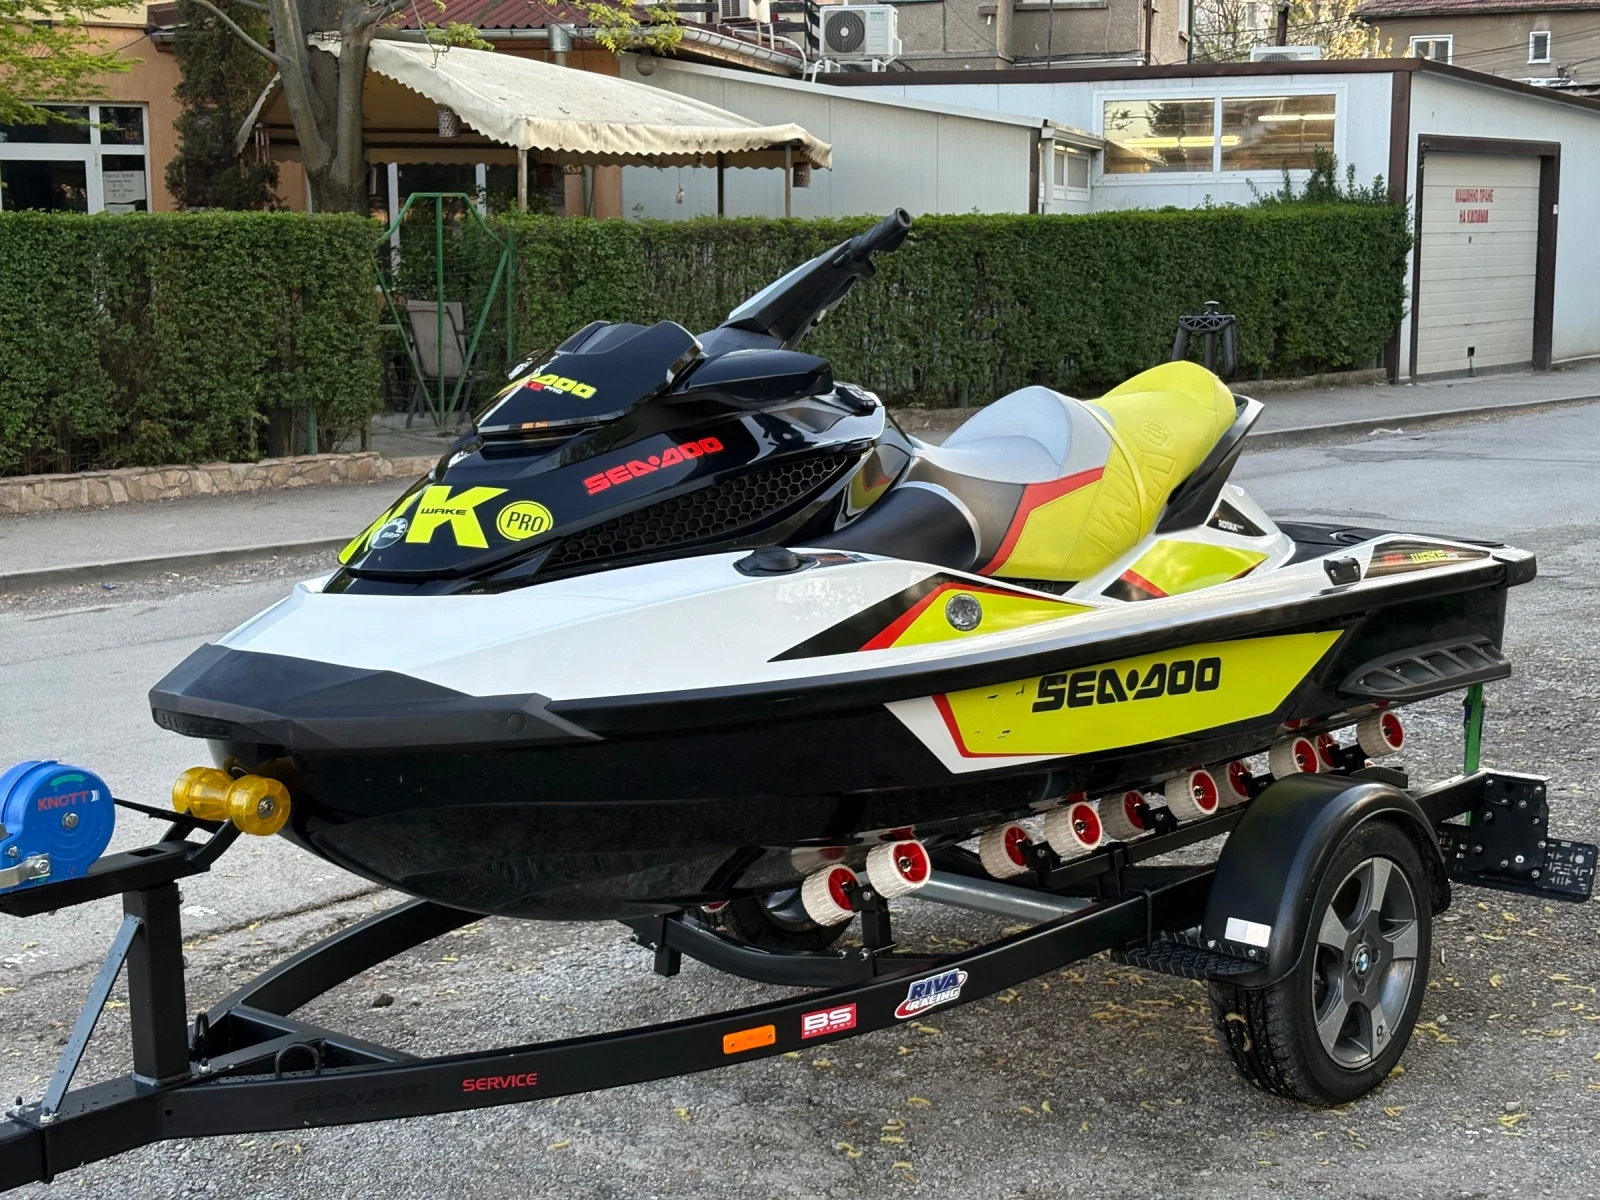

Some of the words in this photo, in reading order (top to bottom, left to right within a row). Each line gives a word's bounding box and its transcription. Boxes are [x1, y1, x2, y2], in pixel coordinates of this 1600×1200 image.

[1459, 209, 1466, 223] НА
[420, 507, 468, 516] WAKE
[506, 511, 545, 533] PRO
[37, 790, 90, 811] KNOTT
[910, 970, 960, 1000] RIVA
[906, 988, 961, 1011] RACING
[804, 1007, 853, 1031] BS
[462, 1073, 538, 1092] SERVICE
